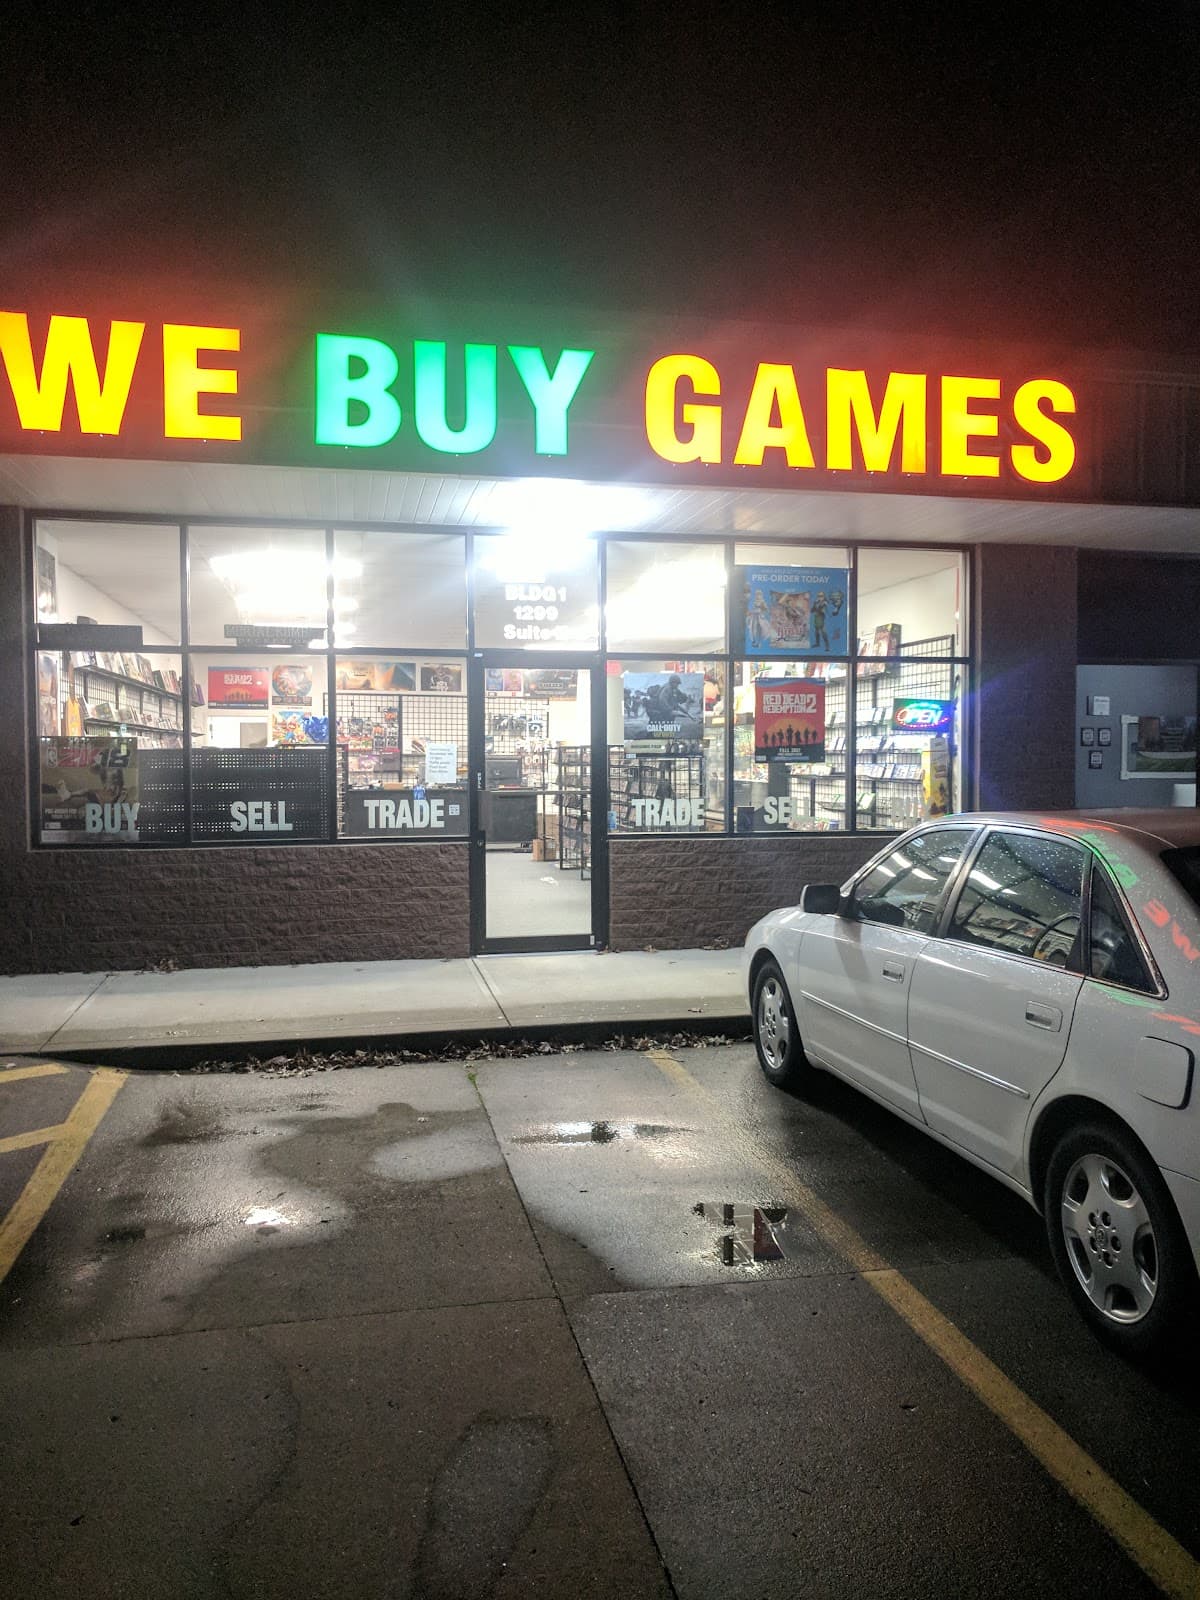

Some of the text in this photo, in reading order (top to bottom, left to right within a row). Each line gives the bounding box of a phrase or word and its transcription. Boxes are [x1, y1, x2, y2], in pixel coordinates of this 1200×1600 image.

[0, 311, 1077, 483] WE BUY GAMES
[752, 574, 830, 584] PRE-ORDER TODAY
[763, 692, 781, 704] RED
[782, 693, 807, 704] DEAD
[646, 723, 663, 732] CALL
[897, 707, 943, 724] OPEN
[85, 802, 140, 833] BUY
[230, 800, 293, 832] SELL
[363, 798, 445, 829] TRADE
[631, 798, 705, 827] TRADE
[763, 796, 815, 825] SELL
